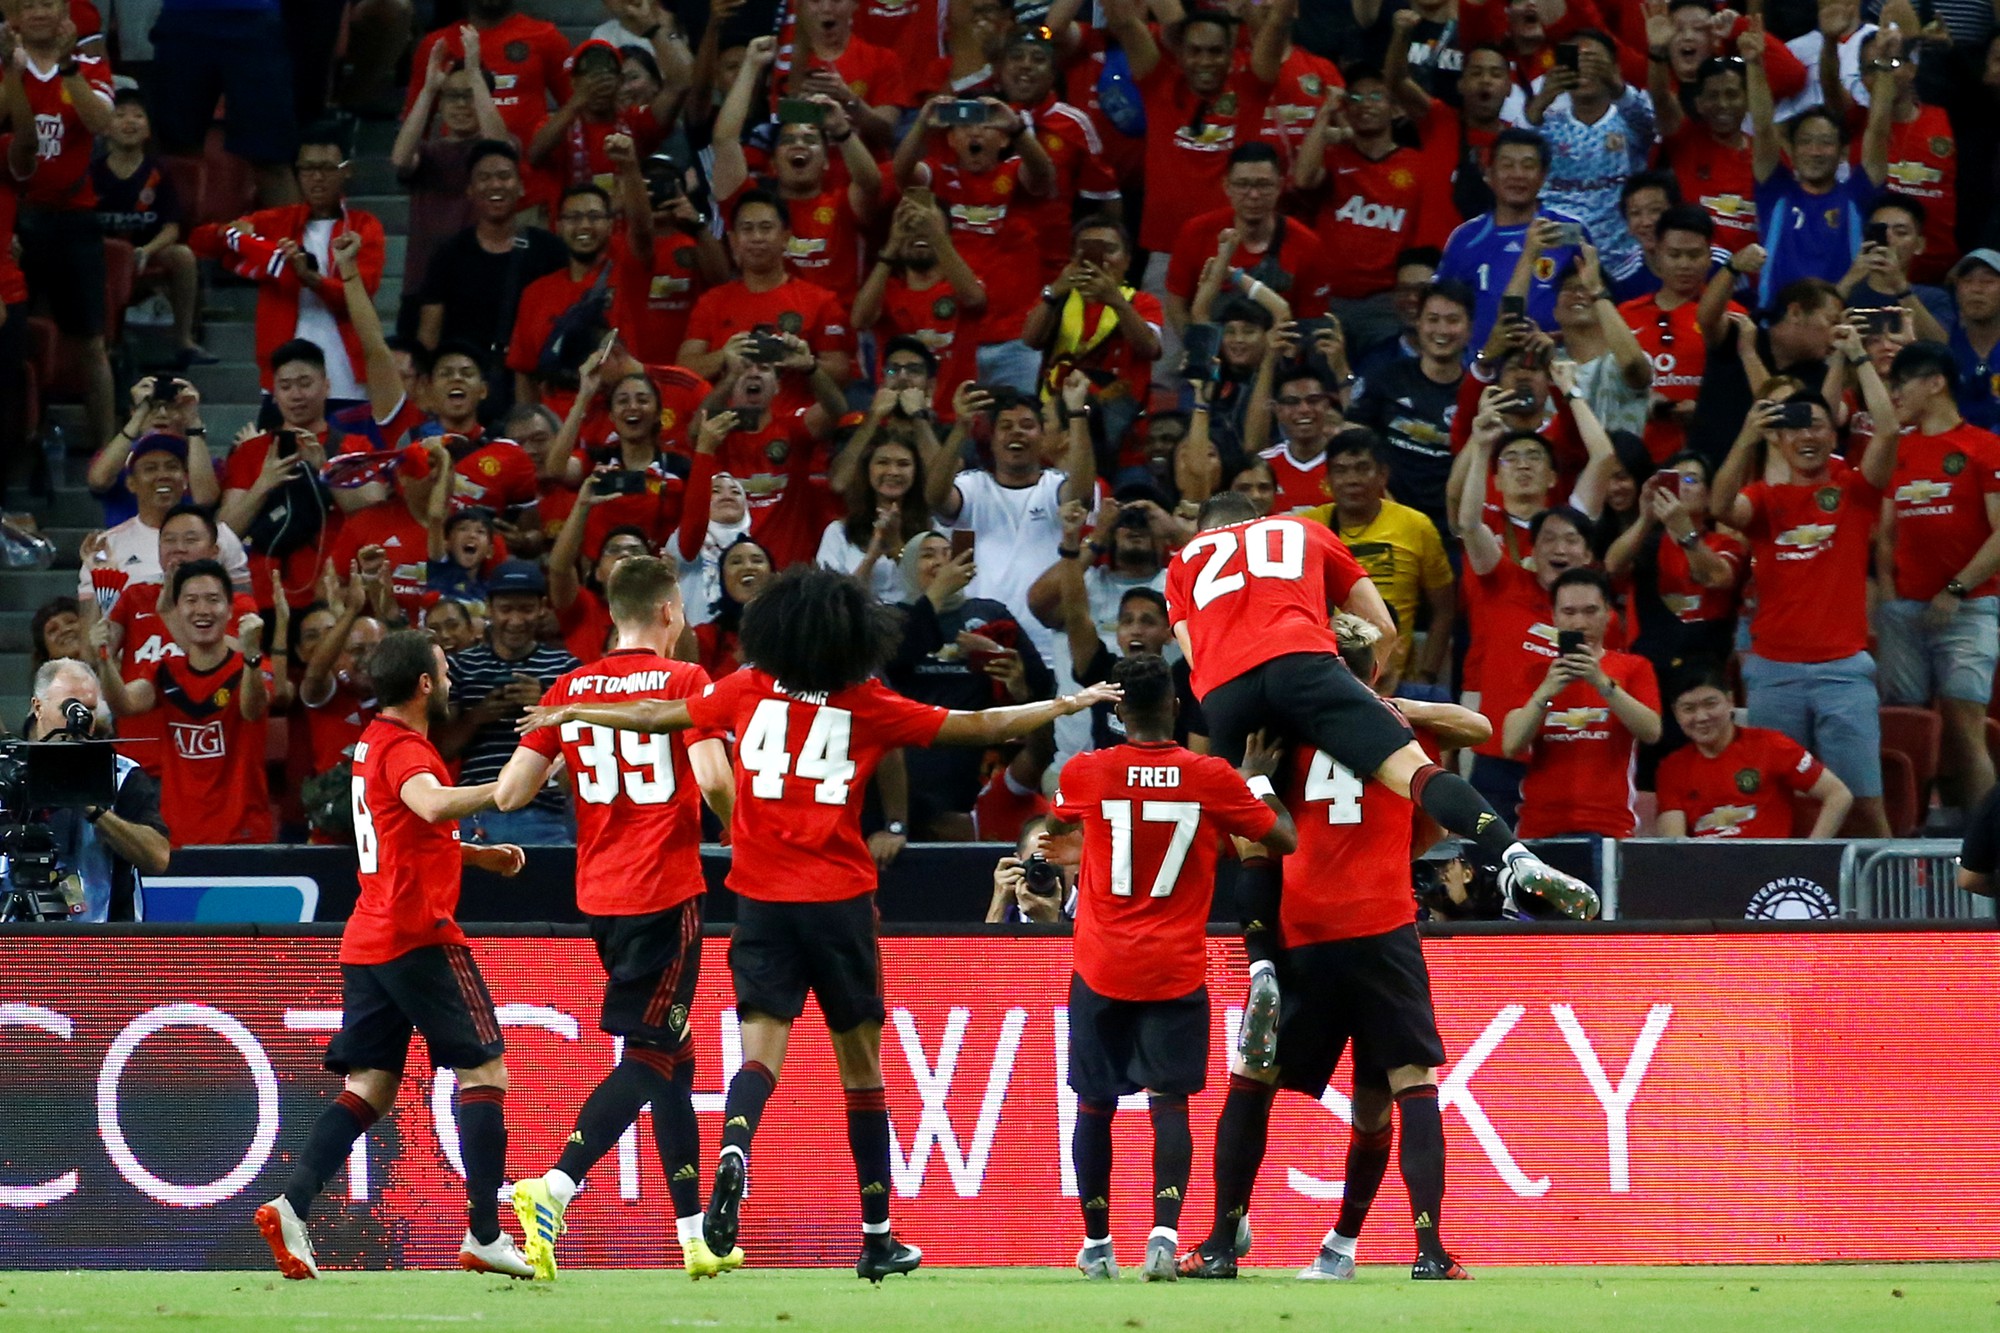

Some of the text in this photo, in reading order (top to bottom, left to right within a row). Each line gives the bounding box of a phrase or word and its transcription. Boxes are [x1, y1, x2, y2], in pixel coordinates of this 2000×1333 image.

[1334, 194, 1406, 232] AON
[1476, 263, 1490, 291] 1
[1181, 517, 1306, 612] 20
[560, 717, 677, 805] 39
[739, 698, 856, 805] 44
[1127, 765, 1181, 788] FRED
[1305, 748, 1364, 825] 4
[1100, 799, 1201, 898] 17
